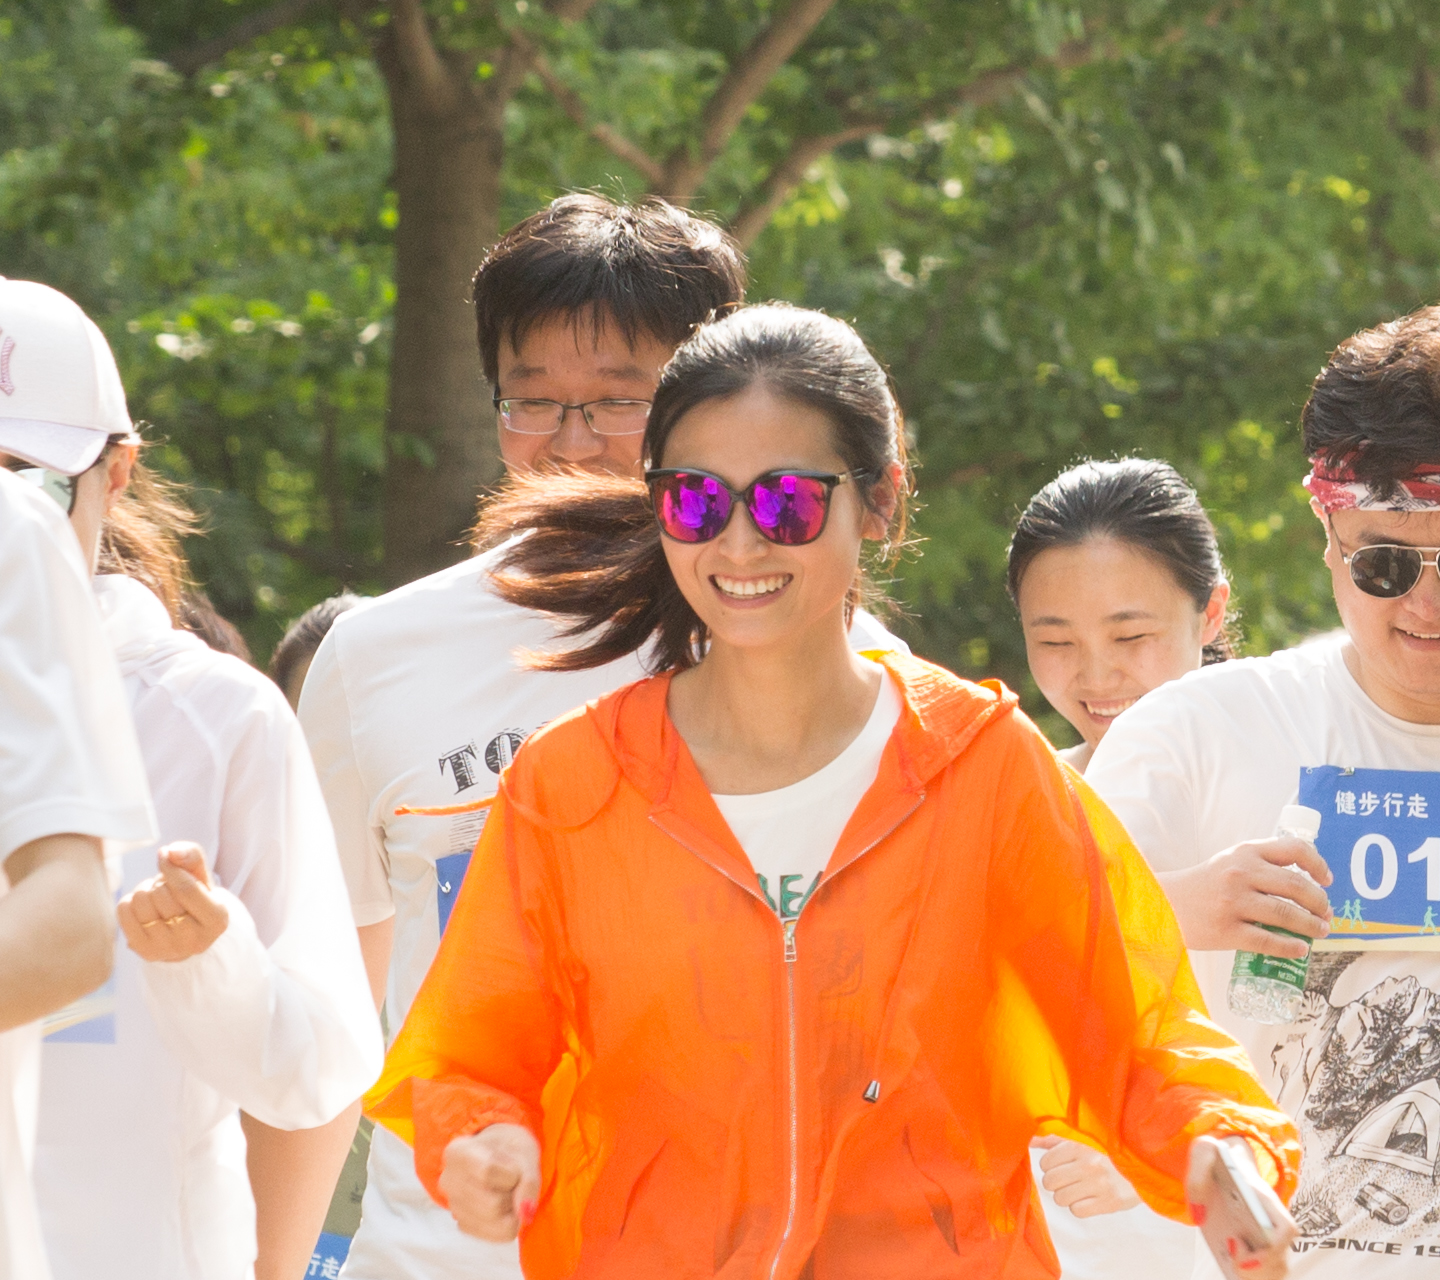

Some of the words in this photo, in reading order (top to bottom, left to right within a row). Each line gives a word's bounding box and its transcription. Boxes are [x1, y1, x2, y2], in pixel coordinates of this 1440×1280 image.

[1334, 789, 1429, 819] 健步行走
[1318, 1238, 1403, 1255] SINCE
